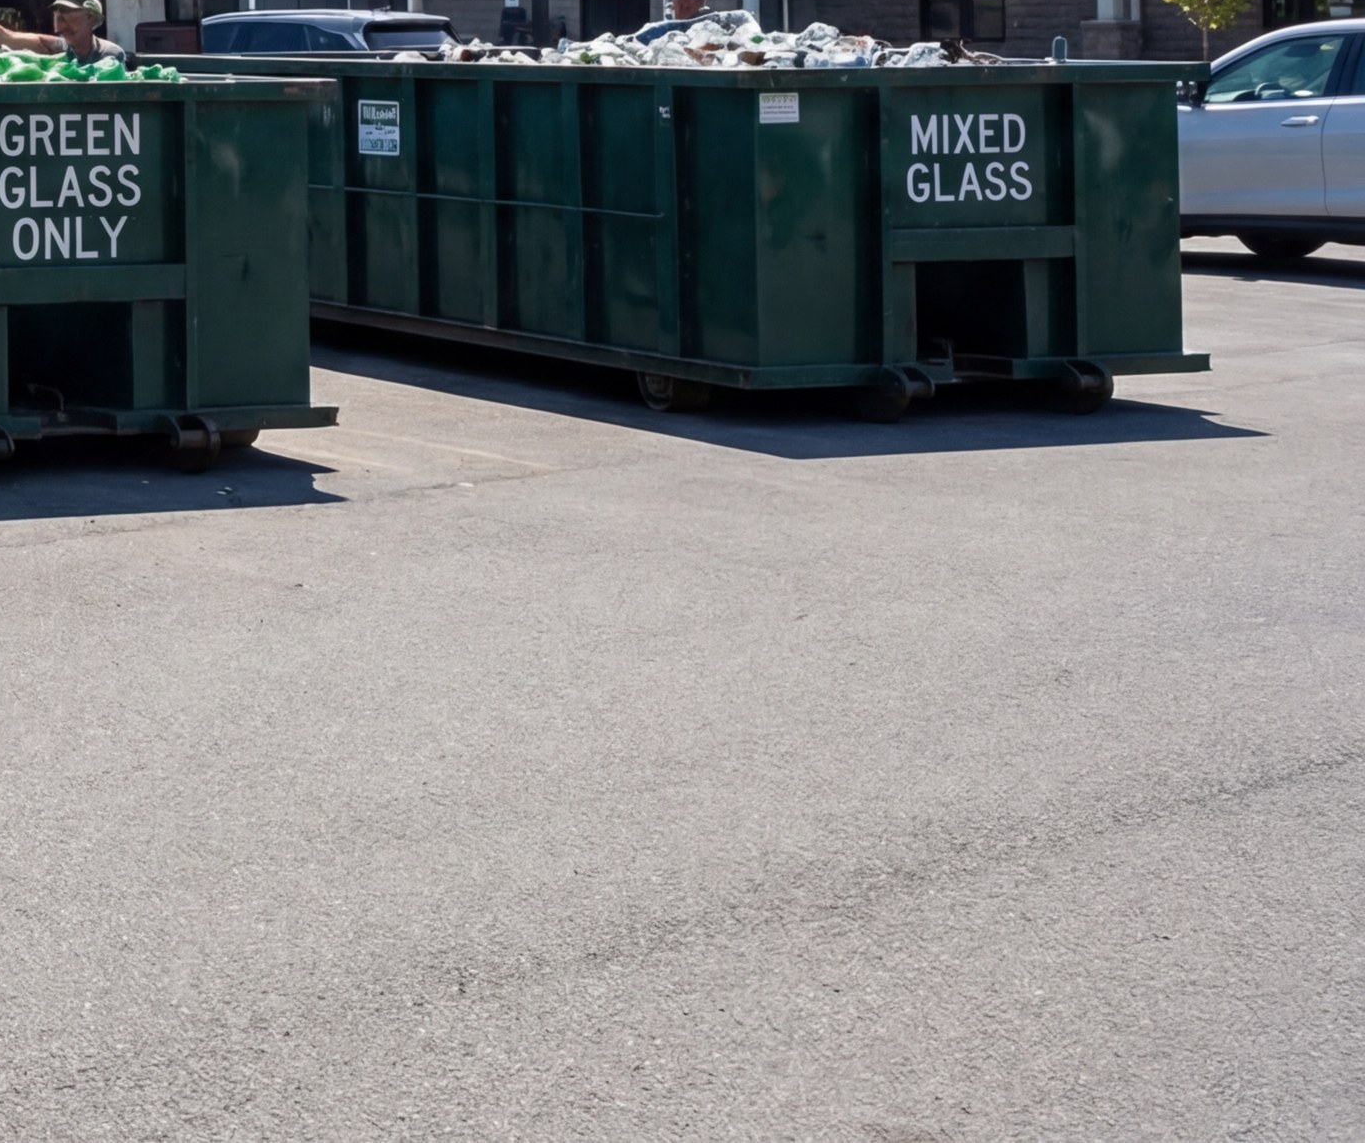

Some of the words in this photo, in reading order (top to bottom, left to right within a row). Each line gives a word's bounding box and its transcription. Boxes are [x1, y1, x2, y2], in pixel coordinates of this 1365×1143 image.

[0, 113, 140, 157] GREEN
[911, 113, 1026, 155] MIXED
[906, 161, 1033, 203] GLASS
[12, 215, 128, 261] ONLY
